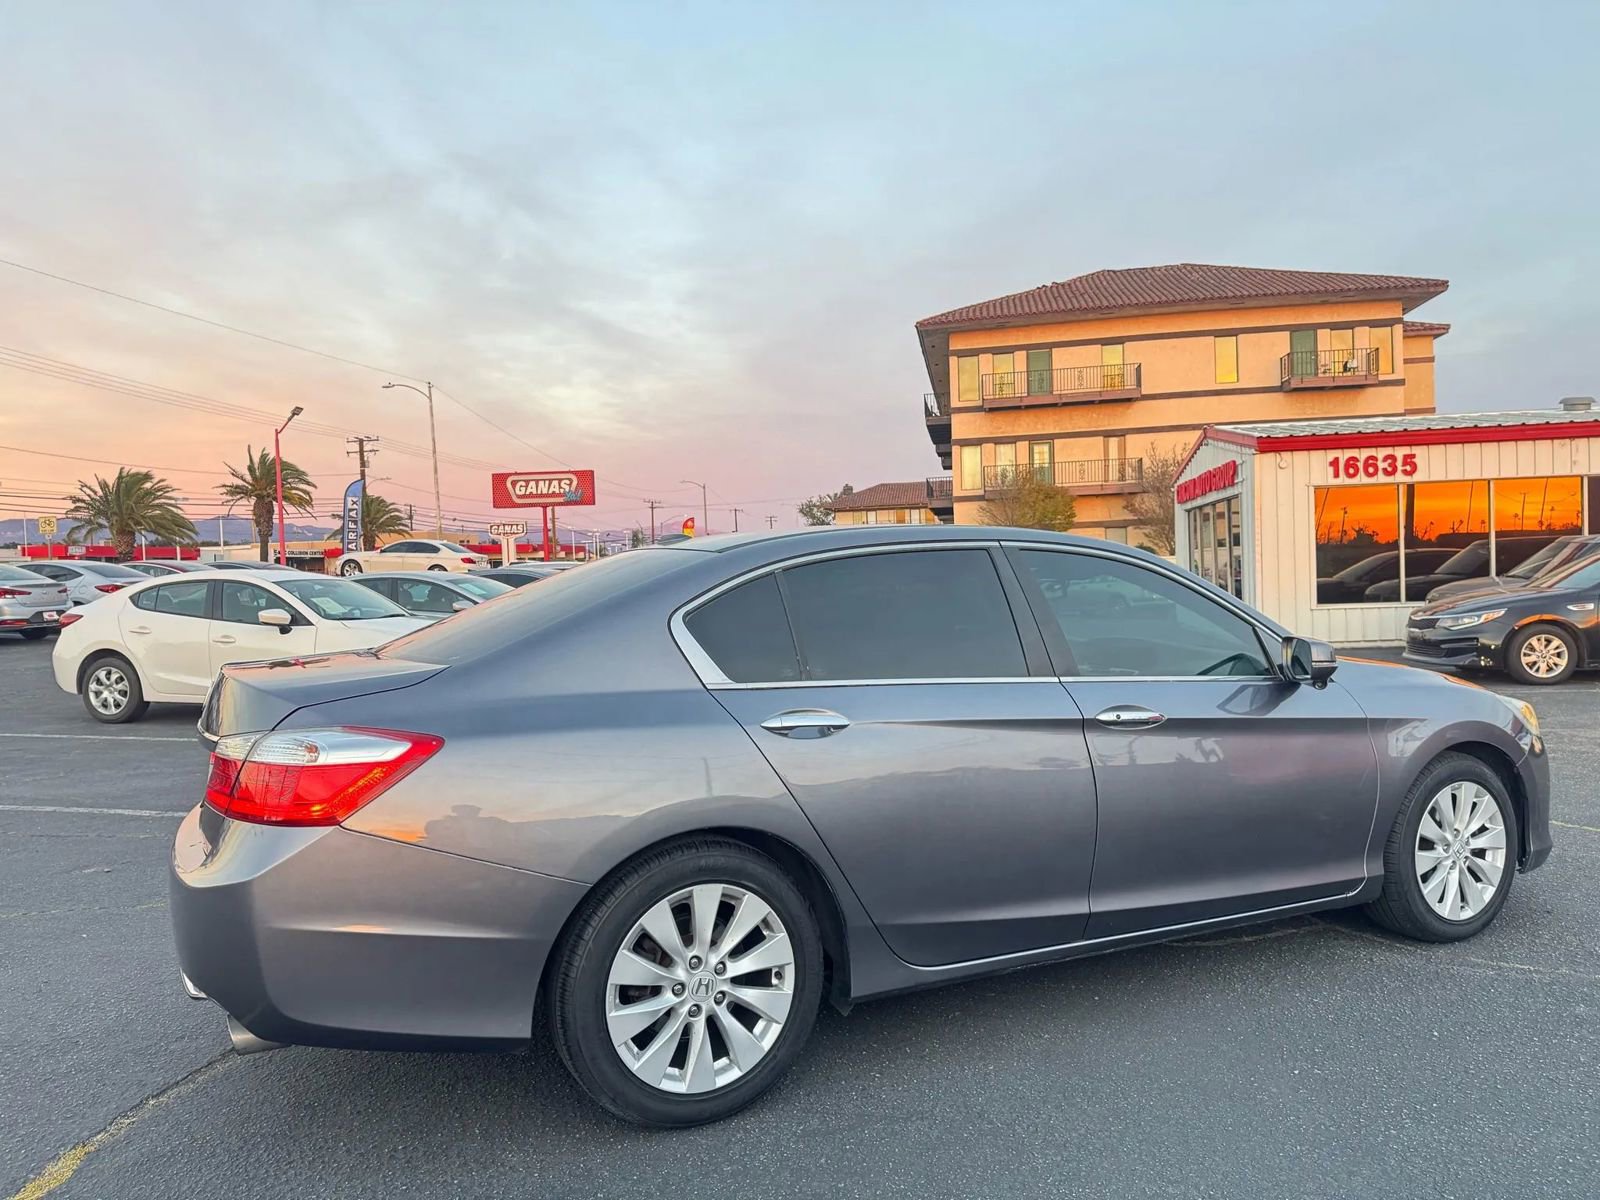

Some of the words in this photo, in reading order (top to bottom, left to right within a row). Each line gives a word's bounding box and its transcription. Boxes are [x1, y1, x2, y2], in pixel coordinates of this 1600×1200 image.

[1211, 460, 1236, 492] GROUP
[1329, 454, 1417, 478] 16635
[515, 479, 571, 495] GANAS
[347, 497, 359, 551] ARFAX
[491, 524, 524, 535] GANAS
